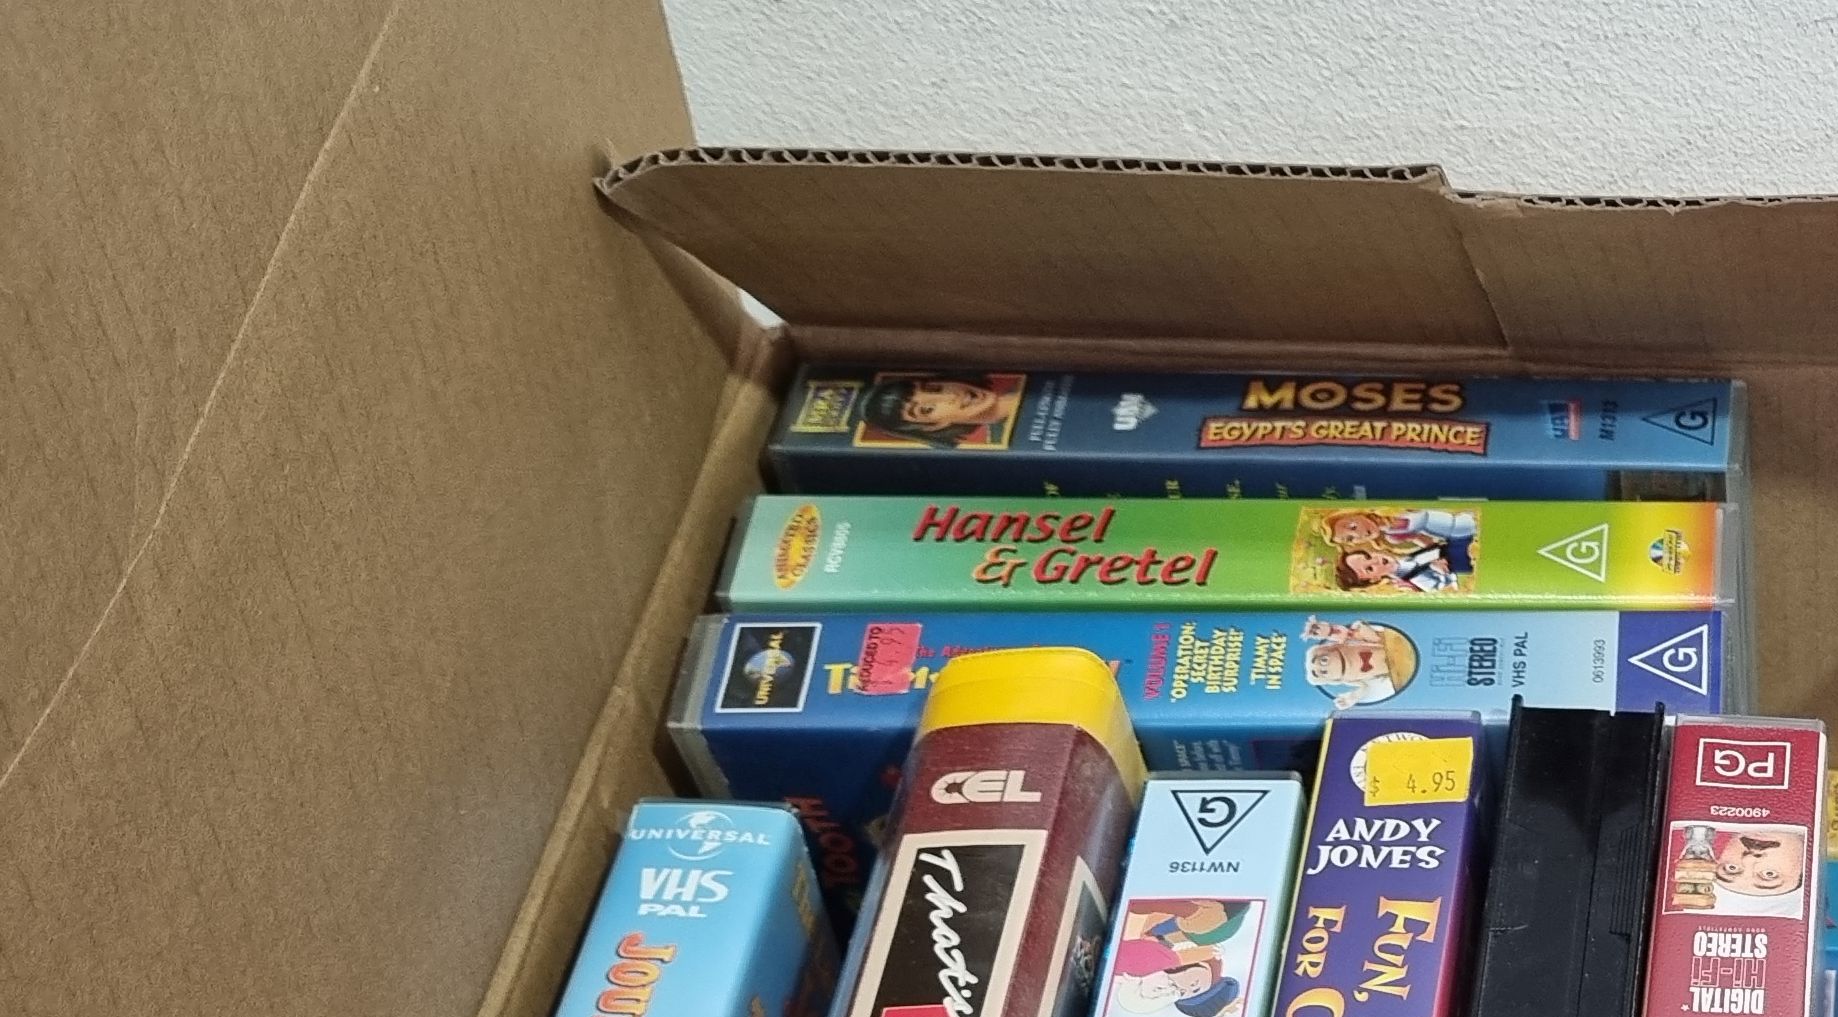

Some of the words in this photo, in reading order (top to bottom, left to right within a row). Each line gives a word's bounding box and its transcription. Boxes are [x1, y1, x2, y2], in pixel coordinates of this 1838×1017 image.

[1241, 380, 1464, 412] MOSES
[1208, 420, 1306, 441] EGYPT'S
[1311, 421, 1387, 440] GREAT
[1391, 424, 1481, 446] PRINCE
[1675, 409, 1709, 431] G
[913, 505, 1115, 543] Hansel
[973, 549, 1023, 586] &
[1031, 546, 1217, 586] Gretel
[1566, 540, 1600, 564] G
[1514, 632, 1529, 657] PAL
[754, 630, 785, 705] UNIVERSAL
[858, 640, 880, 691] REDUCED
[1144, 634, 1170, 700] VOLUME
[1190, 640, 1210, 683] SECRET
[1205, 629, 1227, 693] BIRTHDAY
[1467, 637, 1498, 686] STEREO
[1662, 647, 1698, 672] G
[1265, 675, 1281, 690] IN
[1512, 662, 1527, 688] VHS
[1714, 749, 1775, 779] PG
[931, 770, 1041, 804] CEL
[1369, 776, 1381, 797] $
[1405, 771, 1457, 796] 4.95
[1197, 796, 1237, 828] G
[1710, 805, 1770, 818] 4900223
[630, 827, 770, 846] UNIVERSAL
[1325, 817, 1443, 843] ANDY
[1169, 860, 1240, 874] NW1136
[1307, 844, 1446, 875] JONES
[639, 868, 735, 903] VHS
[637, 903, 709, 918] PAL
[1693, 931, 1768, 958] STEREO
[1691, 956, 1767, 988] HI-FI
[1689, 987, 1765, 1015] DIGITAL
